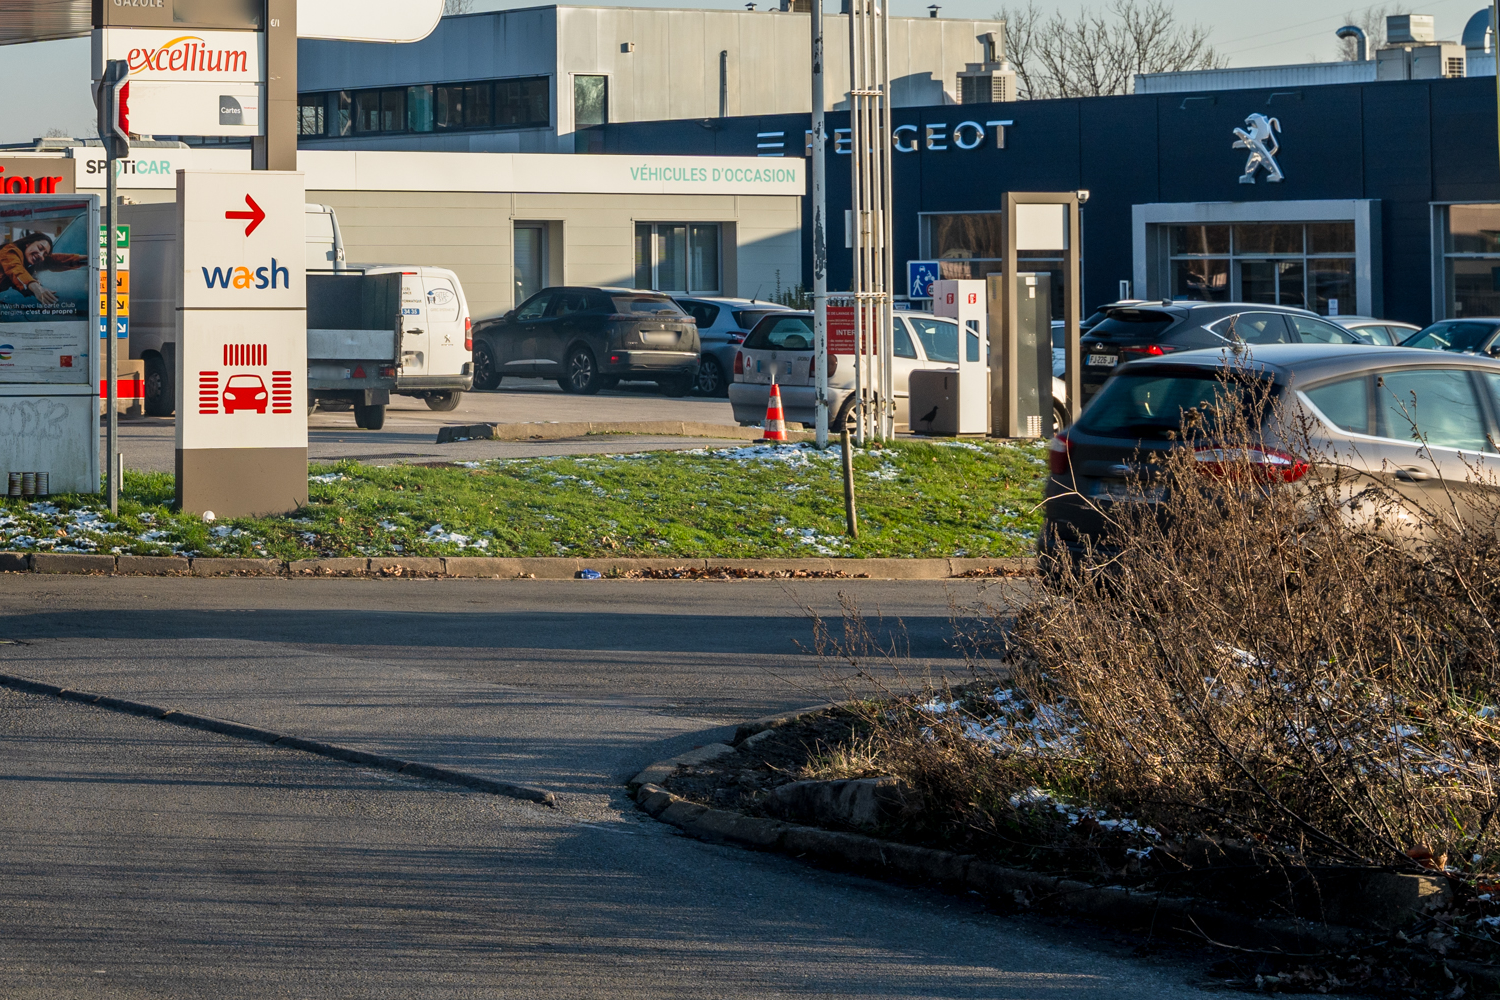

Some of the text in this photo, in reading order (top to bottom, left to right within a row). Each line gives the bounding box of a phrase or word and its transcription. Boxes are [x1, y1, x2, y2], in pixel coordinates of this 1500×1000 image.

[127, 40, 248, 74] excellium
[220, 106, 241, 114] Cartes
[805, 120, 1014, 157] PEGEOT
[630, 163, 796, 183] VÉHICULES D'OCCASION
[201, 257, 290, 290] wash
[746, 356, 751, 368] A
